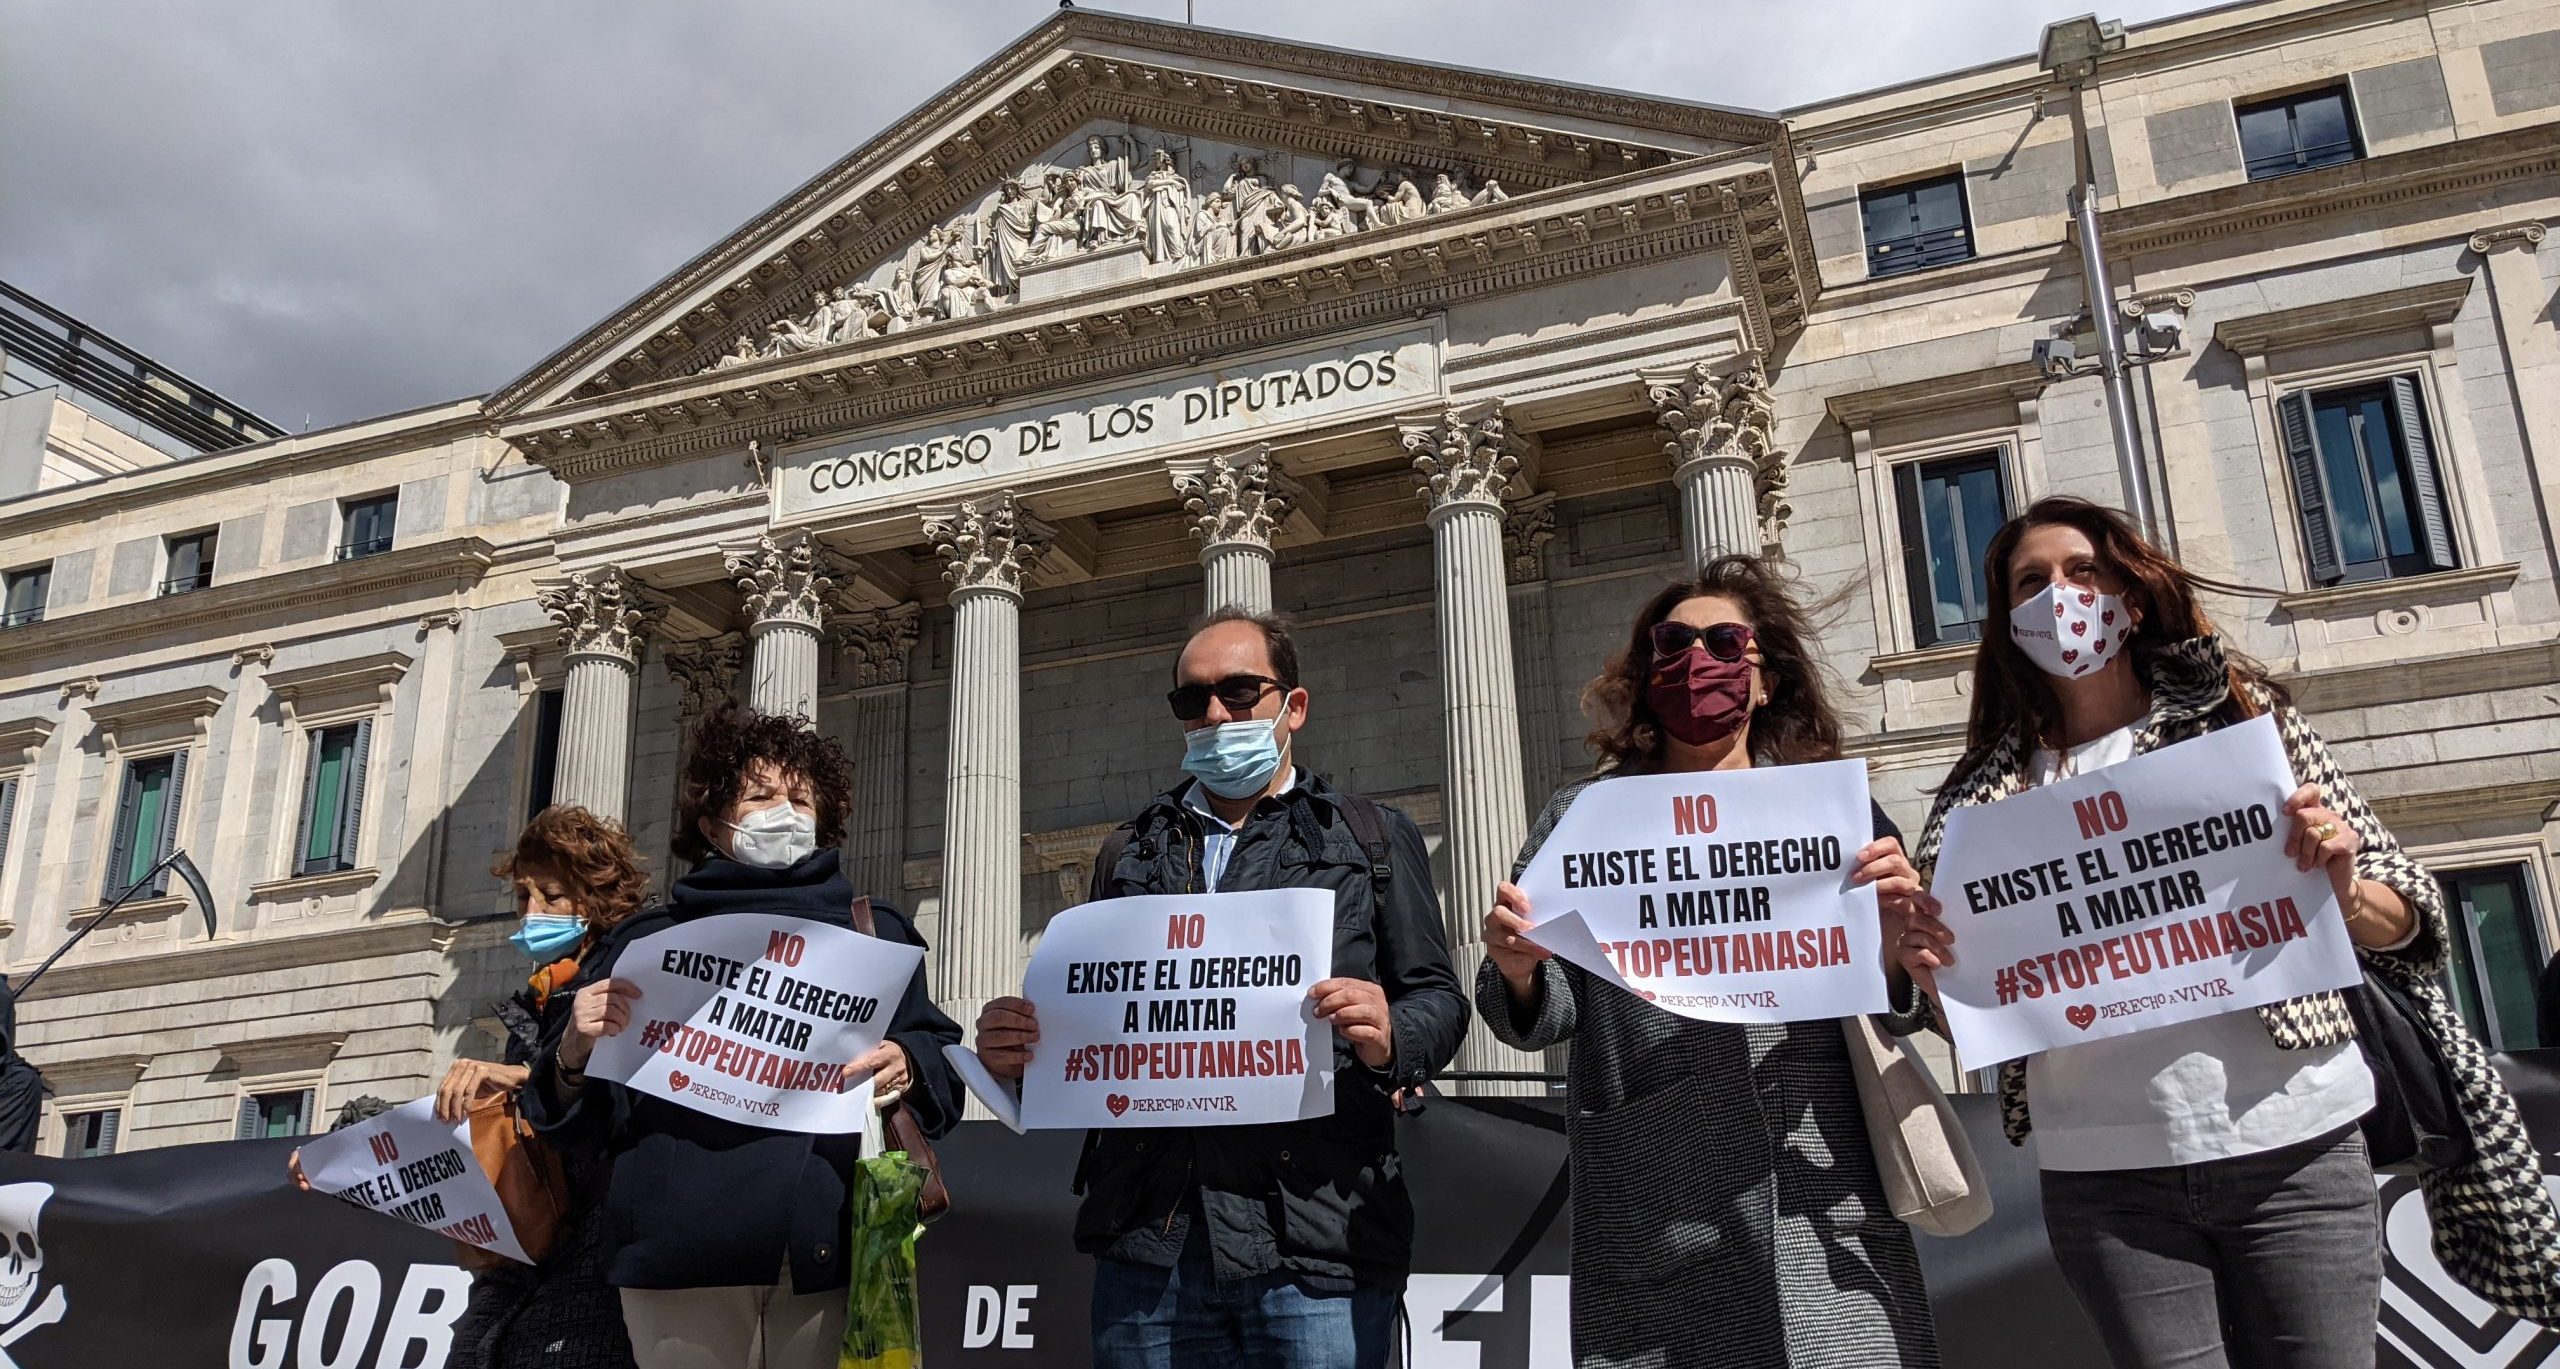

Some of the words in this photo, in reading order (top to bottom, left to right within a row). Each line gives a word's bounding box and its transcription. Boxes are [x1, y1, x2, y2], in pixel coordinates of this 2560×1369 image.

[810, 434, 991, 494] CONGRESO
[1018, 421, 1061, 456] DE
[1088, 403, 1155, 443] LOS
[1184, 355, 1399, 425] DIPUTADOS
[1672, 794, 1718, 836] NO
[2073, 790, 2129, 840] NO
[1562, 849, 1657, 889] EXISTE
[1666, 846, 1700, 881] EL
[1708, 835, 1841, 877] DERECHO
[1963, 858, 2074, 915] EXISTE
[2076, 847, 2119, 886] EL
[2122, 803, 2273, 874] DERECHO
[1639, 895, 1658, 929] A
[1665, 887, 1771, 928] MATAR
[2056, 901, 2081, 938] A
[2087, 869, 2207, 930] MATAR
[765, 930, 805, 967] NO
[1167, 914, 1205, 949] NO
[1600, 926, 1850, 978] TOPEUTANASIA
[1994, 896, 2308, 1006] #STOPEUTANASIA
[661, 949, 744, 990] EXISTE
[745, 966, 768, 998] EL
[774, 976, 878, 1024] DERECHO
[1066, 960, 1146, 994] EXISTE
[1154, 959, 1180, 990] EL
[1189, 954, 1301, 988] DERECHO
[1123, 1001, 1139, 1033] A
[1147, 998, 1236, 1032] MATAR
[1660, 995, 1718, 1008] DERECHO
[1727, 991, 1779, 1008] VIVIR
[2100, 995, 2166, 1020] DERECHO
[2175, 978, 2234, 1002] VIVIR
[707, 996, 726, 1027] A
[728, 1002, 812, 1052] MATAR
[639, 1020, 846, 1094] #STOPEUTANASIA
[1064, 1038, 1304, 1082] #STOPEUTANASIA
[689, 1081, 735, 1105] DERECHO
[742, 1098, 780, 1117] VIVIR
[1132, 1098, 1185, 1113] DERECHO
[1193, 1095, 1238, 1112] VIVIR
[368, 1131, 399, 1166] NO
[377, 1172, 400, 1202] EL
[398, 1148, 466, 1193] DERECHO
[963, 1284, 1038, 1348] DE
